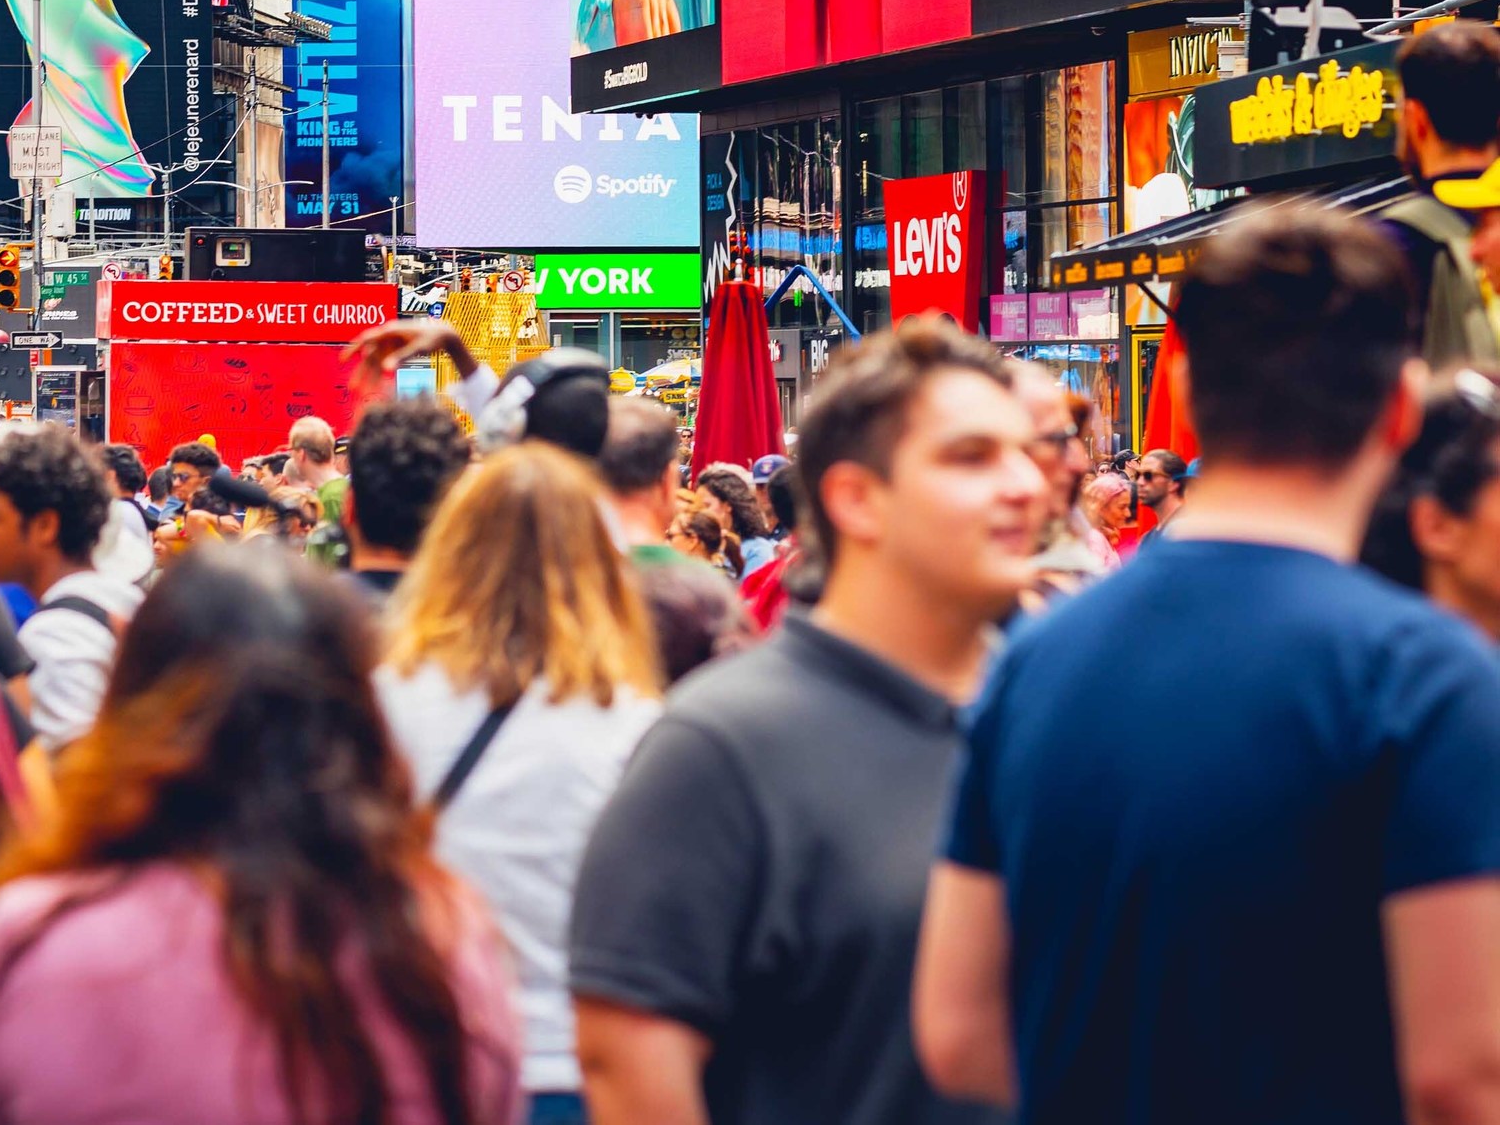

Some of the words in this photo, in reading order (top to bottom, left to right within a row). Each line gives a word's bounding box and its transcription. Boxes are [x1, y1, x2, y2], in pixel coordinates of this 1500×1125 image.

[183, 38, 200, 173] @lejeunerenard
[296, 120, 341, 136] KING
[343, 120, 356, 128] OF
[341, 128, 358, 136] THE
[12, 132, 37, 141] RIGHT
[39, 132, 60, 141] LANE
[296, 136, 359, 147] MONTERS
[22, 146, 51, 158] MUST
[12, 162, 35, 172] TURN
[37, 162, 61, 172] RIGHT
[596, 171, 674, 198] Spotify
[297, 193, 308, 201] IN
[311, 193, 359, 201] THATERS
[297, 201, 335, 215] MAY
[340, 201, 360, 215] 31
[54, 274, 64, 284] W
[66, 274, 78, 284] 45
[558, 267, 653, 295] YORK
[121, 300, 244, 324] COFFEED
[245, 308, 255, 319] &
[256, 303, 307, 325] SWEET
[312, 303, 386, 326] CHURROS
[18, 336, 34, 344] ONE
[39, 336, 55, 344] WAY
